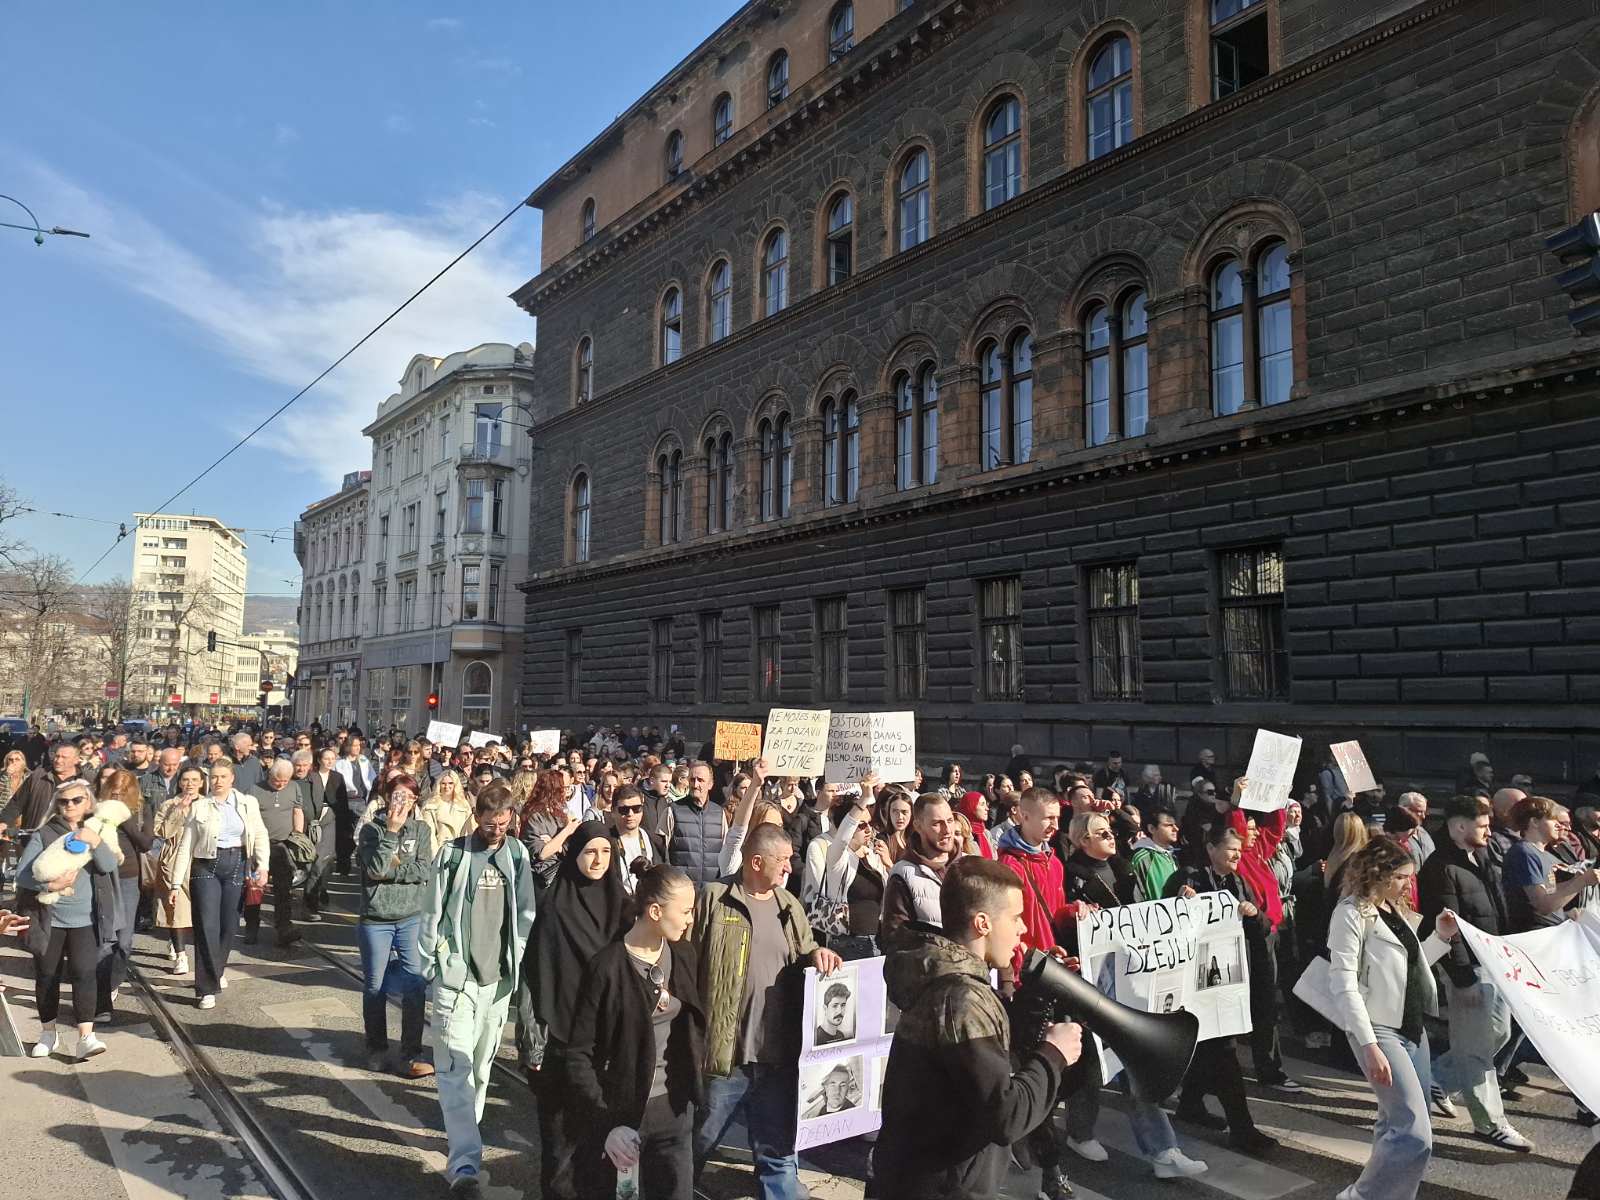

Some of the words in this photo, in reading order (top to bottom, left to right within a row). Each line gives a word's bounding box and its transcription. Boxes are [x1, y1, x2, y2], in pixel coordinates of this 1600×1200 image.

[770, 711, 783, 722] NE
[830, 714, 885, 729] OŠTOVANI
[769, 726, 783, 735] ZA
[874, 730, 901, 741] DANAS
[773, 738, 792, 750] BITI
[852, 743, 864, 752] NA
[873, 741, 895, 753] ČASU
[900, 743, 912, 753] DA
[776, 754, 816, 770] ISTINE
[826, 753, 851, 763] BISMO
[853, 754, 881, 766] SUTRA
[885, 756, 903, 766] BILI
[1090, 896, 1194, 945] PRAVDA
[1199, 891, 1234, 925] ZA
[1124, 936, 1197, 976] DŽEJLU
